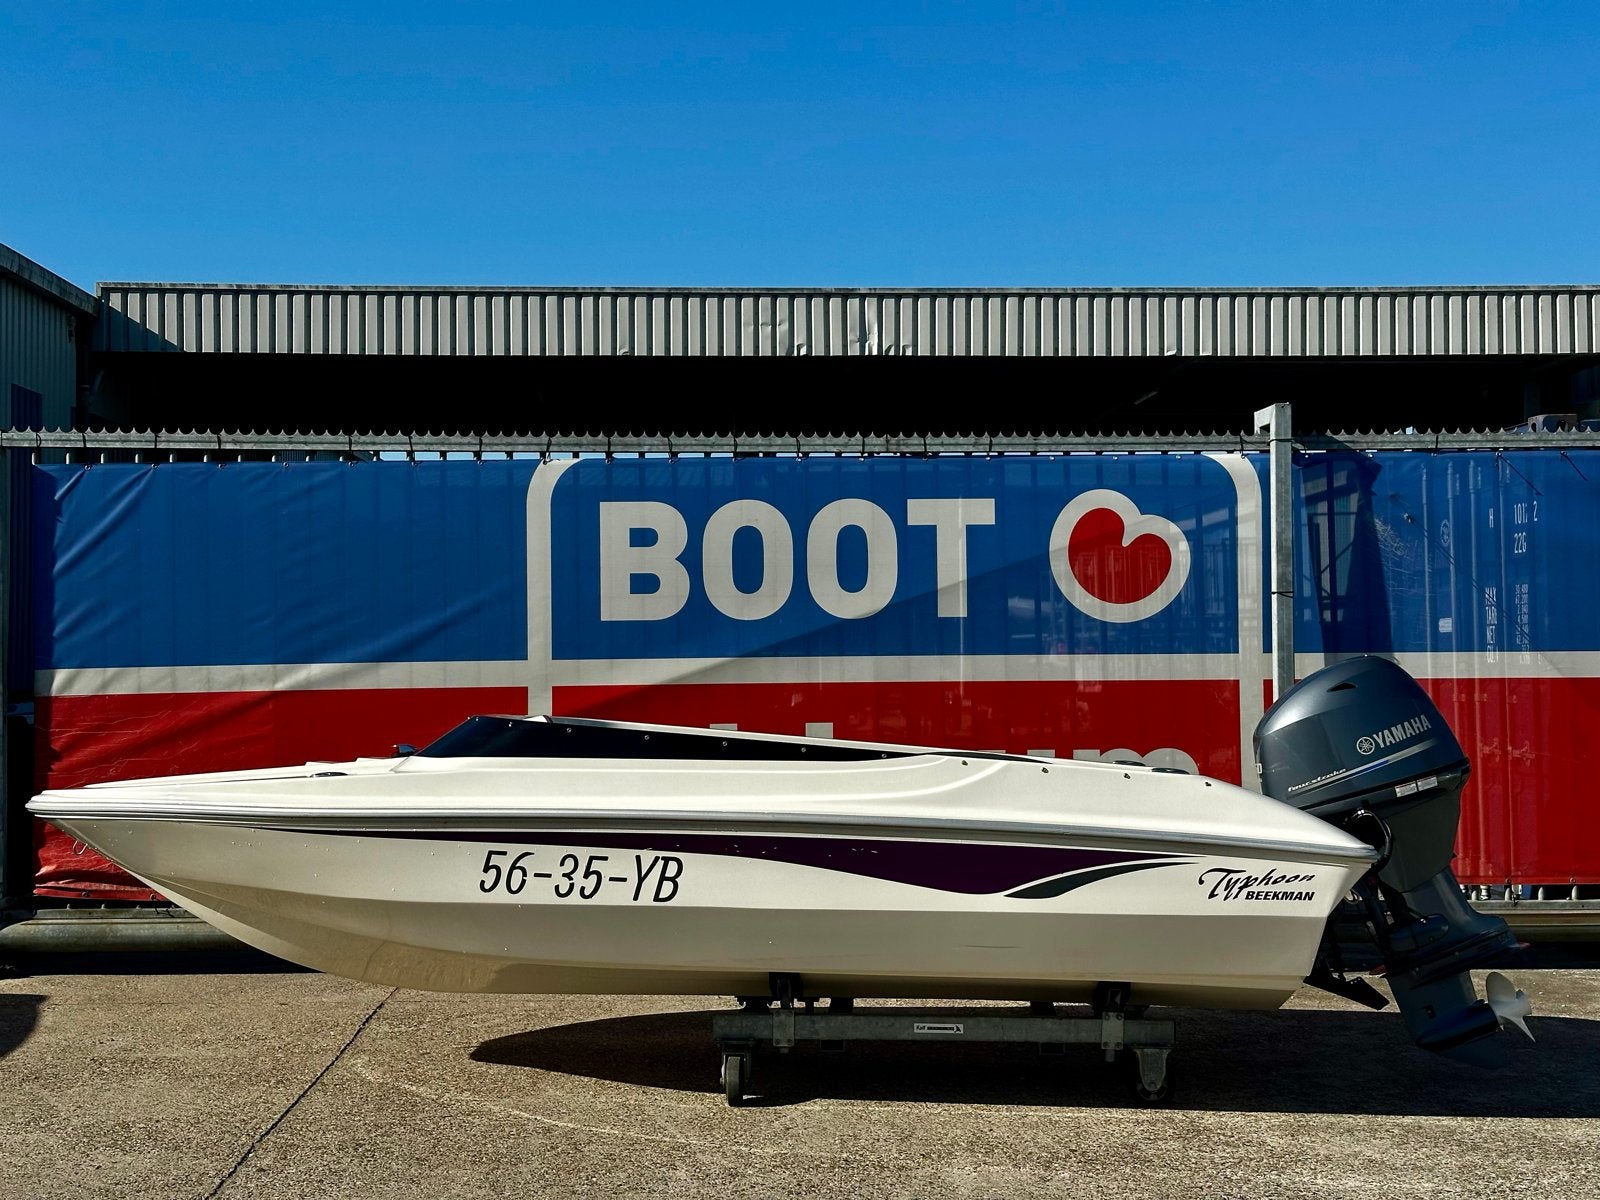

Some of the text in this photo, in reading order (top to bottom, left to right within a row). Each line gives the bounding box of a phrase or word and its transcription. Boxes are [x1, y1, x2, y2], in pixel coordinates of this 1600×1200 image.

[600, 498, 996, 621] BOOT
[1372, 714, 1432, 748] YAMAHA
[479, 850, 684, 903] 56-35-YB
[1198, 867, 1316, 901] Typhoon
[1244, 890, 1316, 901] BEEKMAN
